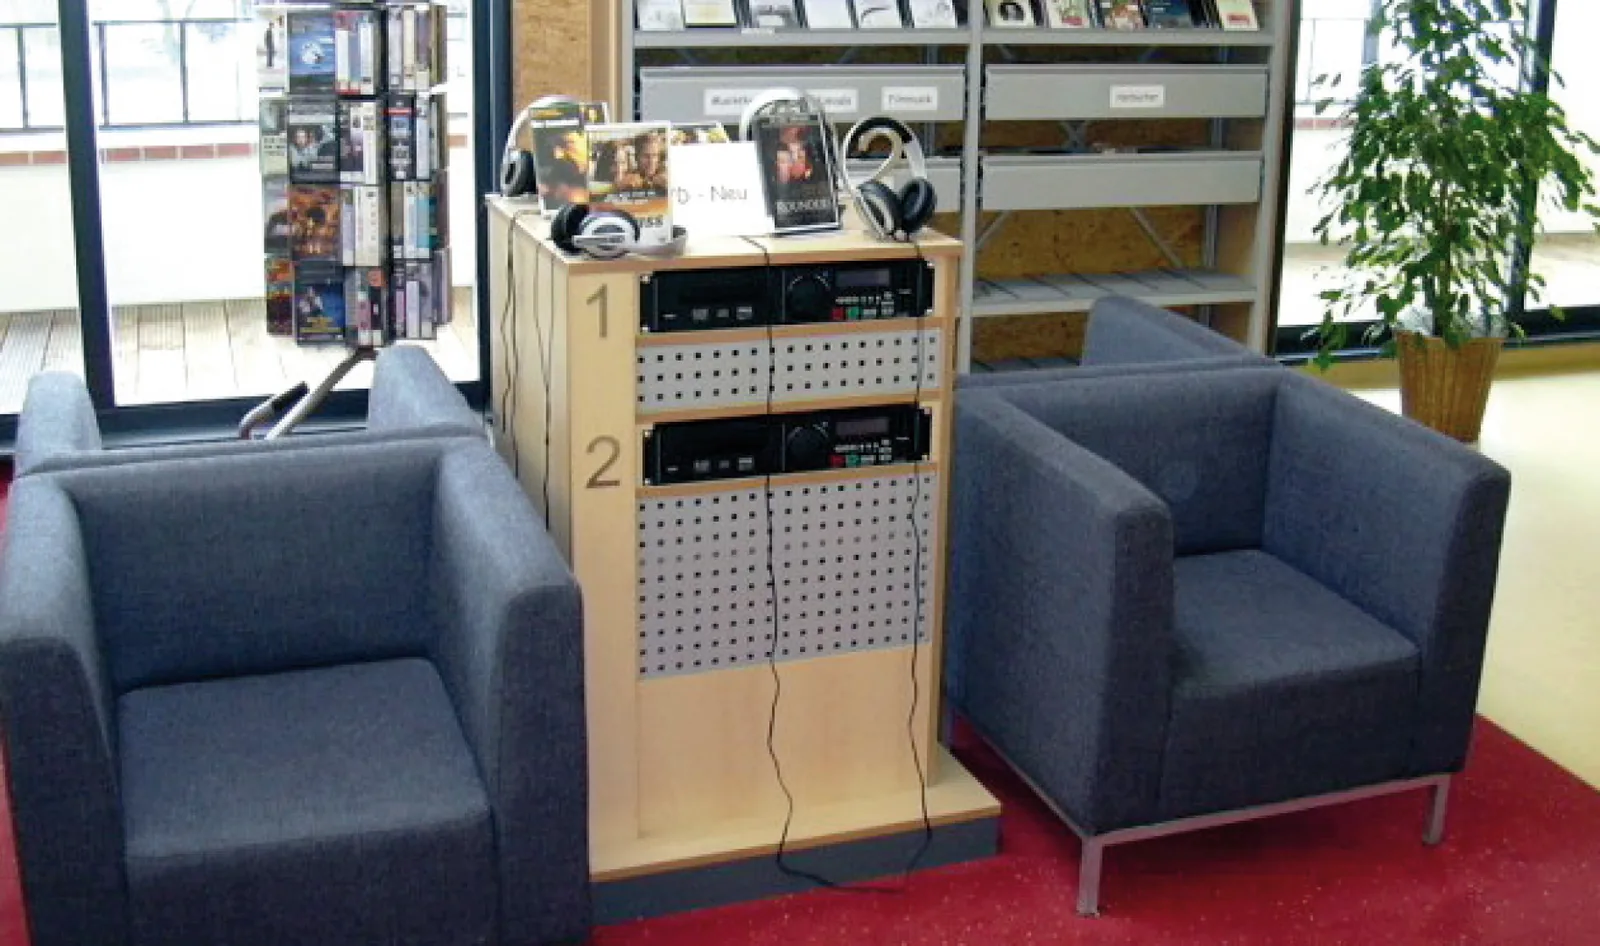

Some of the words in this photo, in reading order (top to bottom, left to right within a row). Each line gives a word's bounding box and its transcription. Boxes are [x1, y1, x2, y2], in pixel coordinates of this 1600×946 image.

[710, 186, 748, 203] Neu
[585, 283, 608, 338] 1
[585, 434, 621, 489] 2
